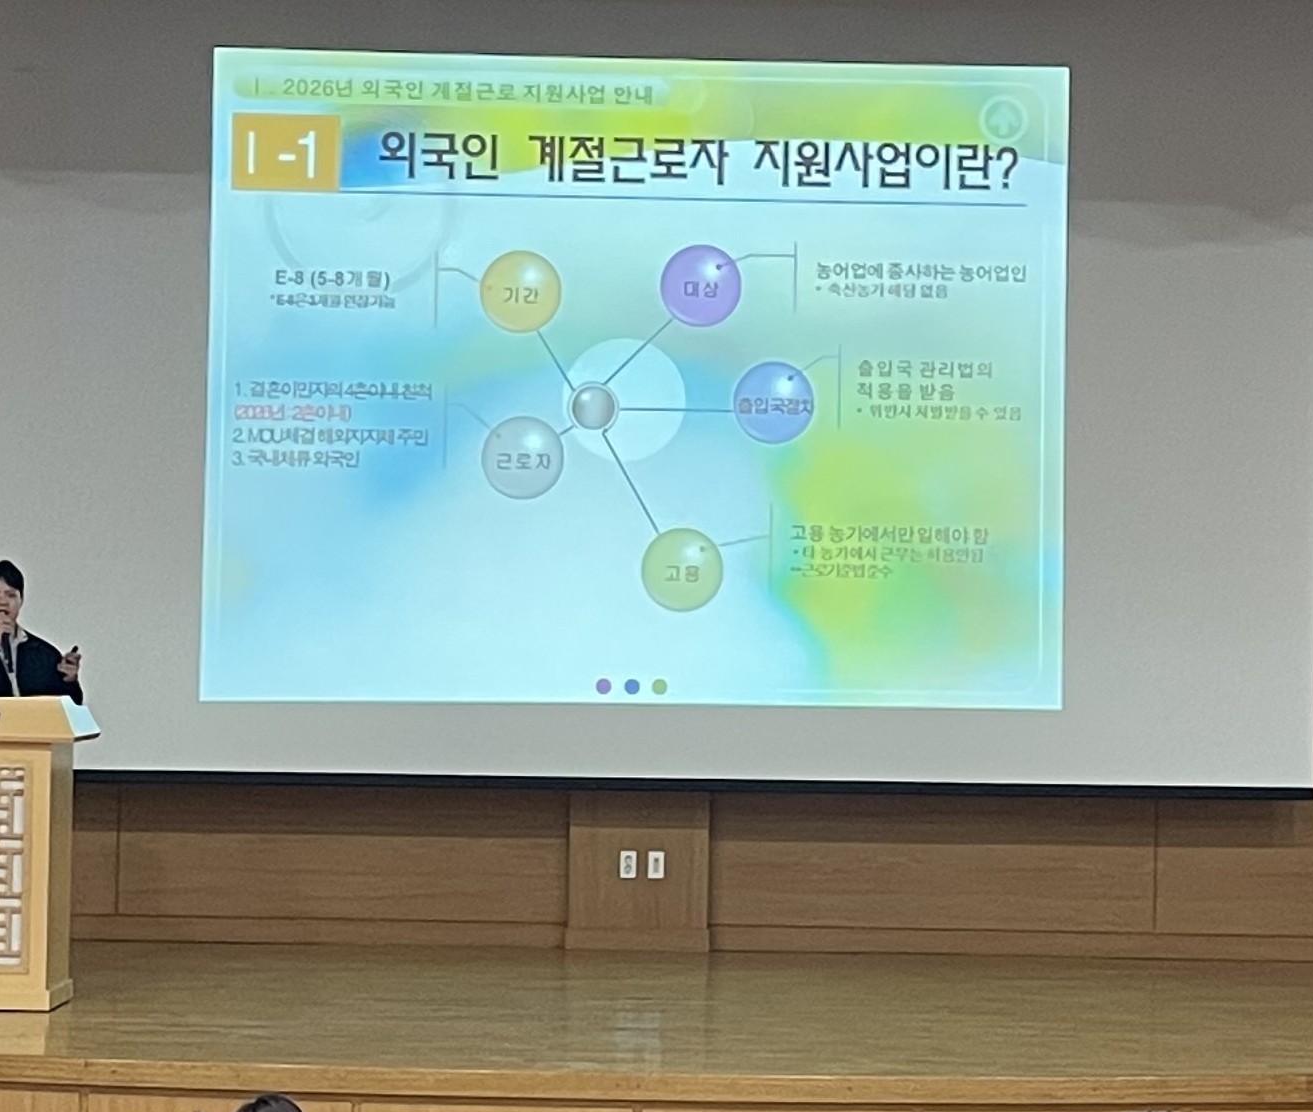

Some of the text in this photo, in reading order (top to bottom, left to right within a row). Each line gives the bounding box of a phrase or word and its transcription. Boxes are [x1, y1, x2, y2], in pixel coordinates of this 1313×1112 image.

[284, 78, 354, 98] 2026년
[361, 80, 423, 100] 외국인
[431, 82, 517, 101] 계절근로
[523, 83, 605, 104] 지원사업
[614, 85, 653, 105] 안내
[378, 131, 1020, 191] 외국인 계절근로자 지원사업이란?
[275, 270, 304, 285] E-8
[815, 262, 884, 280] 농어업에
[959, 264, 1027, 283] 농어업인
[503, 287, 539, 304] 기간
[683, 281, 718, 298] 대상
[858, 360, 993, 379] 출입국 관리법의
[857, 382, 955, 401] 적용을 받음
[497, 453, 551, 470] 근로자
[665, 565, 700, 582] 고용
